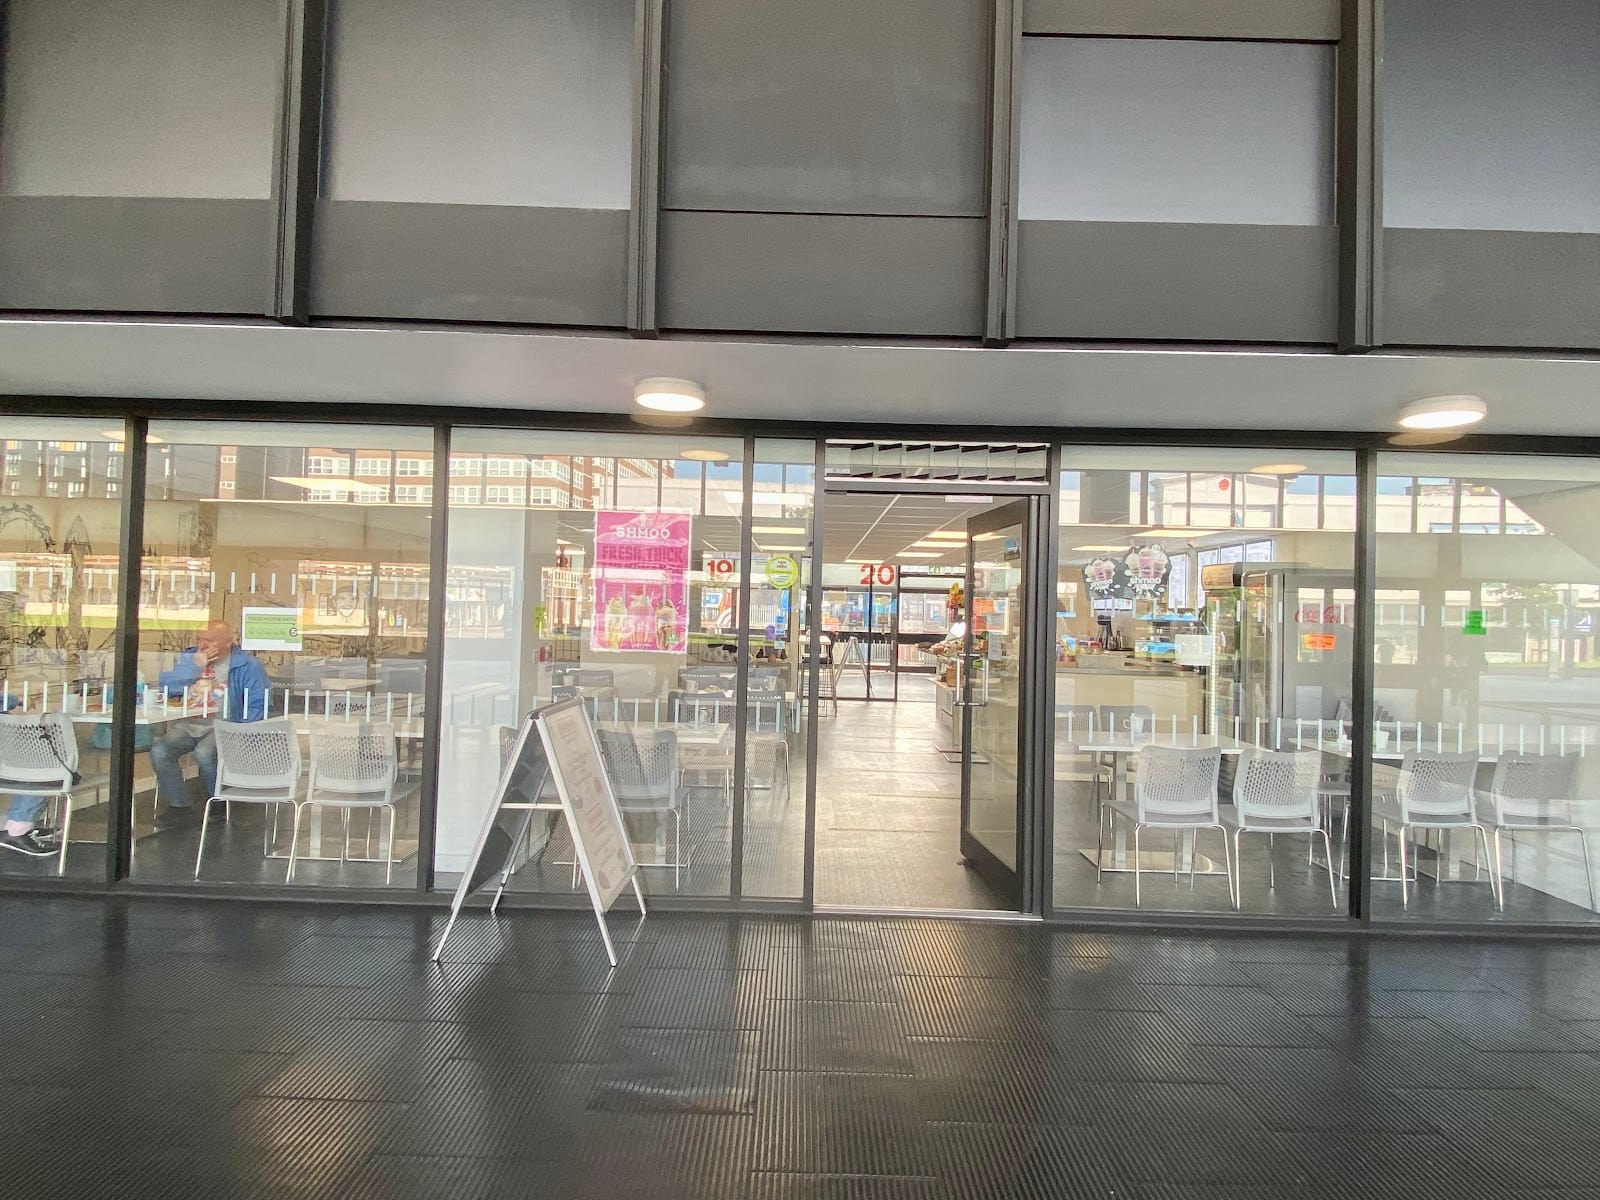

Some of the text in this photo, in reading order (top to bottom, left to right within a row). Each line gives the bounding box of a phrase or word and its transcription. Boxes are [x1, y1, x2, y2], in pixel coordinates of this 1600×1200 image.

[616, 527, 670, 539] SHMOO
[645, 546, 684, 564] THICK
[859, 563, 895, 585] 20
[1129, 576, 1162, 585] shmoo
